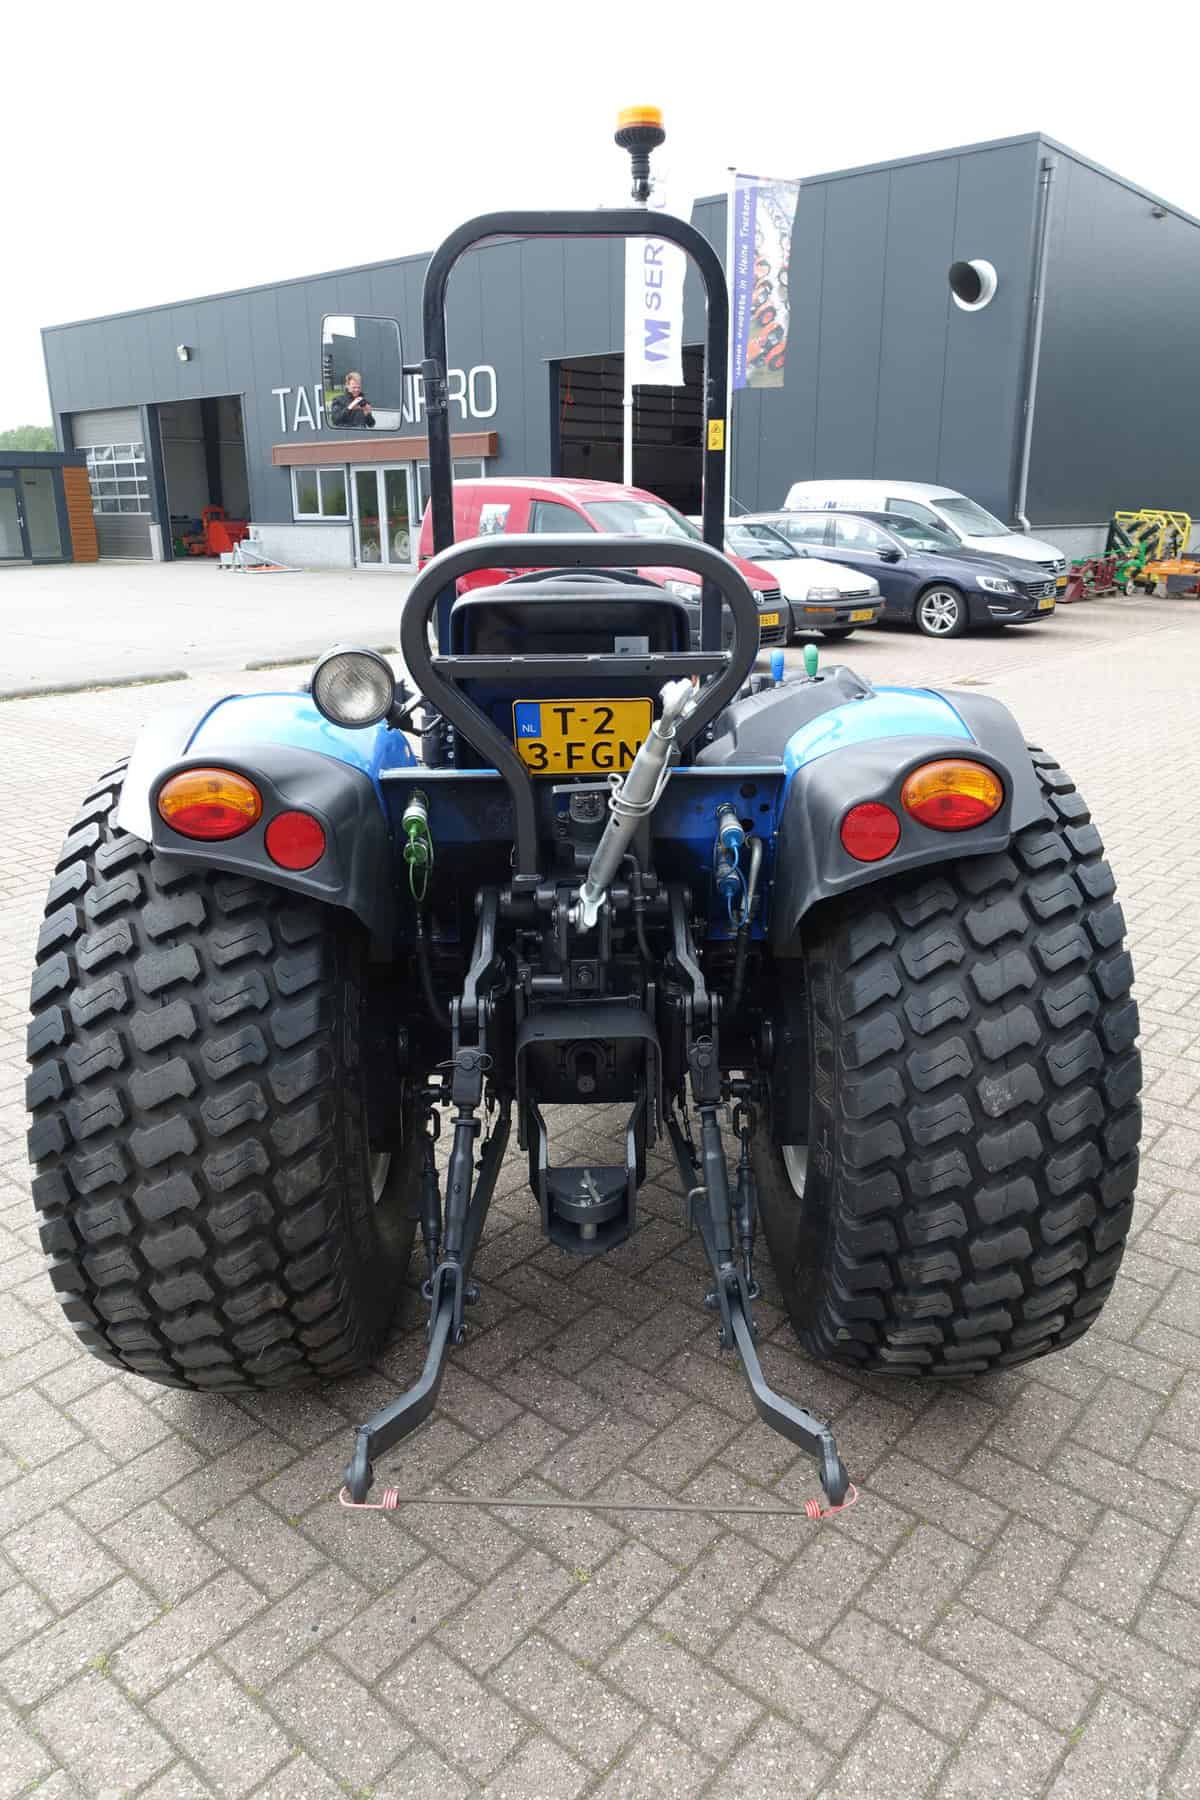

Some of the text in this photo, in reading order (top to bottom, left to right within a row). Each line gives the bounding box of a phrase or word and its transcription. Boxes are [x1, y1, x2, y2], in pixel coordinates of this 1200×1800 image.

[522, 724, 537, 733] NL
[553, 706, 615, 735] T-2
[527, 741, 642, 770] 3-FGN
